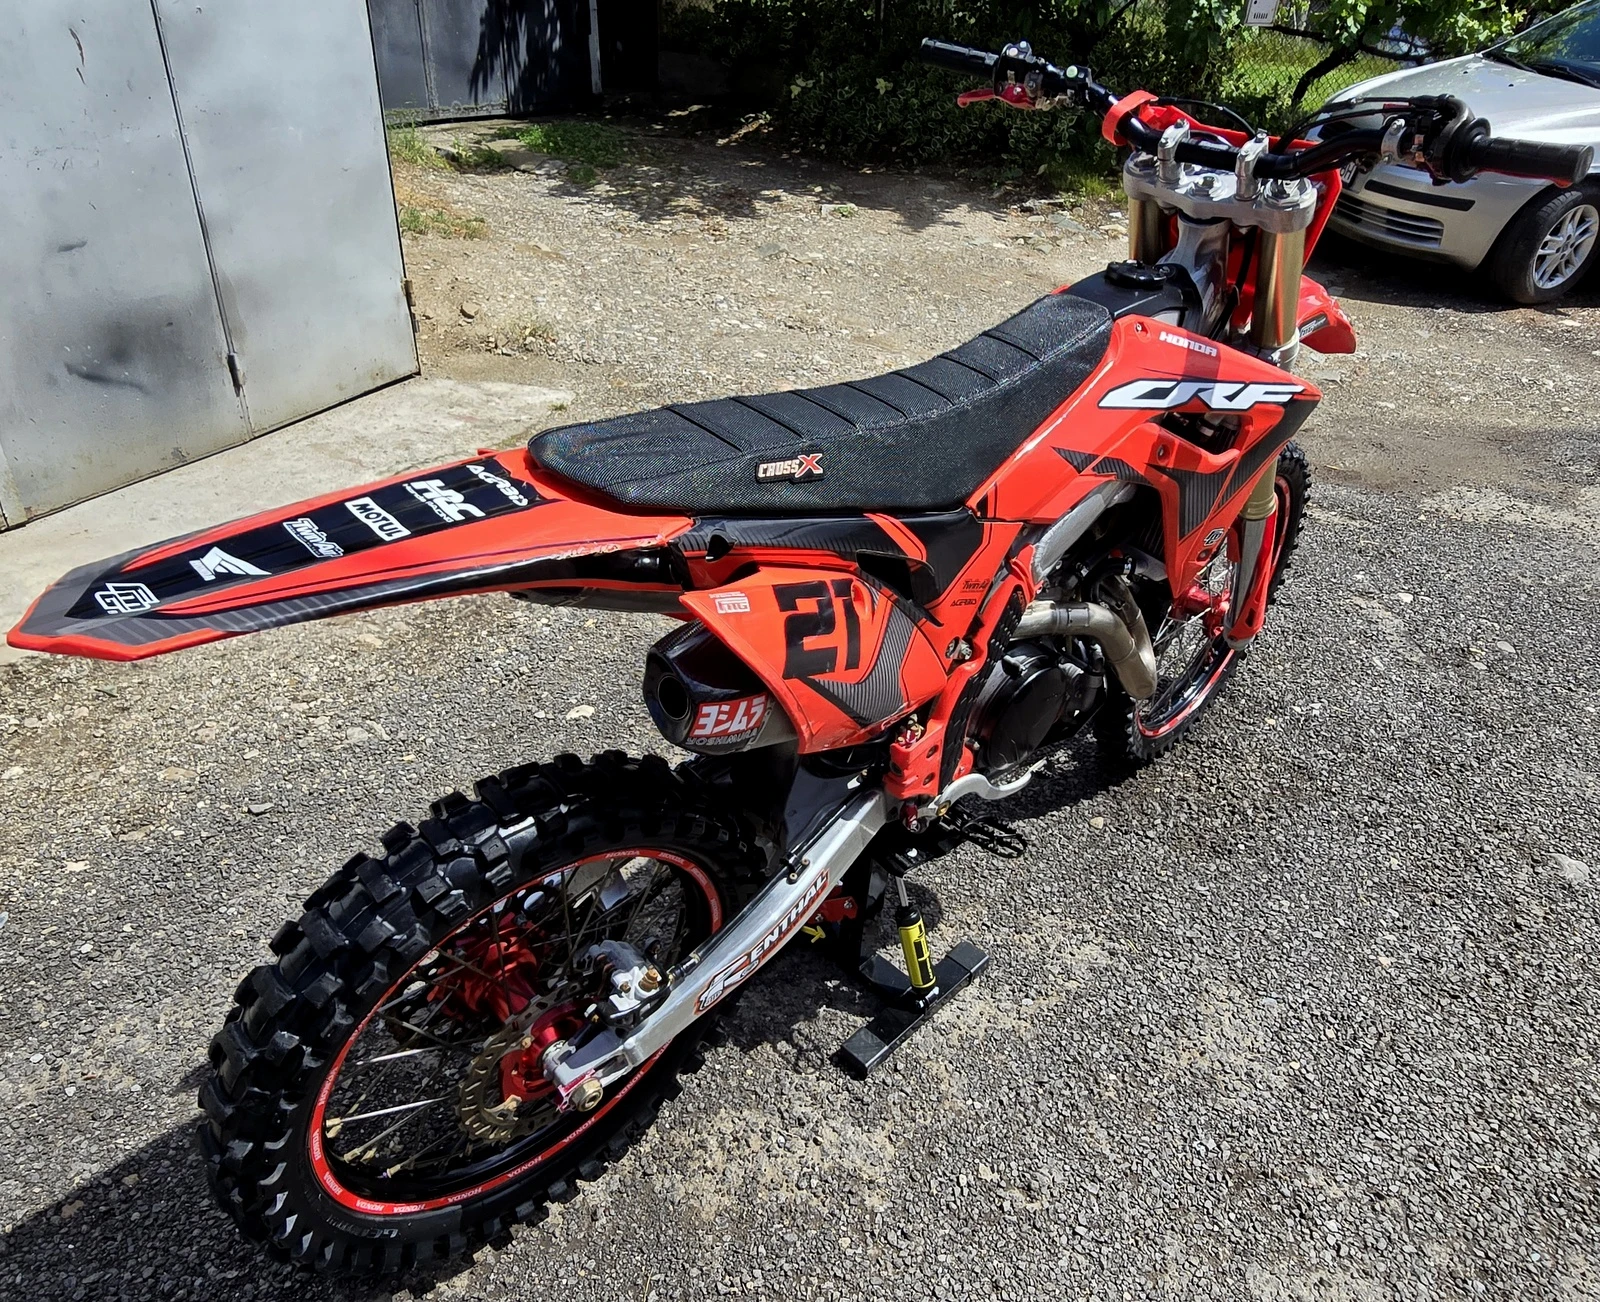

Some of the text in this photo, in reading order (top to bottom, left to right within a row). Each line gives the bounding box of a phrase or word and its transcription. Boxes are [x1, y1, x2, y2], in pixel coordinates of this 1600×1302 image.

[1158, 331, 1217, 357] HONDA
[1098, 380, 1306, 409] CRF
[410, 479, 486, 521] HRC
[351, 502, 404, 538] MOTUL
[772, 578, 861, 680] 21
[693, 695, 766, 735] ヨシムラ
[685, 728, 758, 746] YOSHIMURA
[605, 851, 641, 859] HONDA
[616, 1070, 645, 1100] HONDA
[562, 1116, 597, 1143] HONDA
[507, 1155, 544, 1178] HONDA
[356, 1199, 385, 1211] HONDA
[447, 1187, 483, 1203] HONDA
